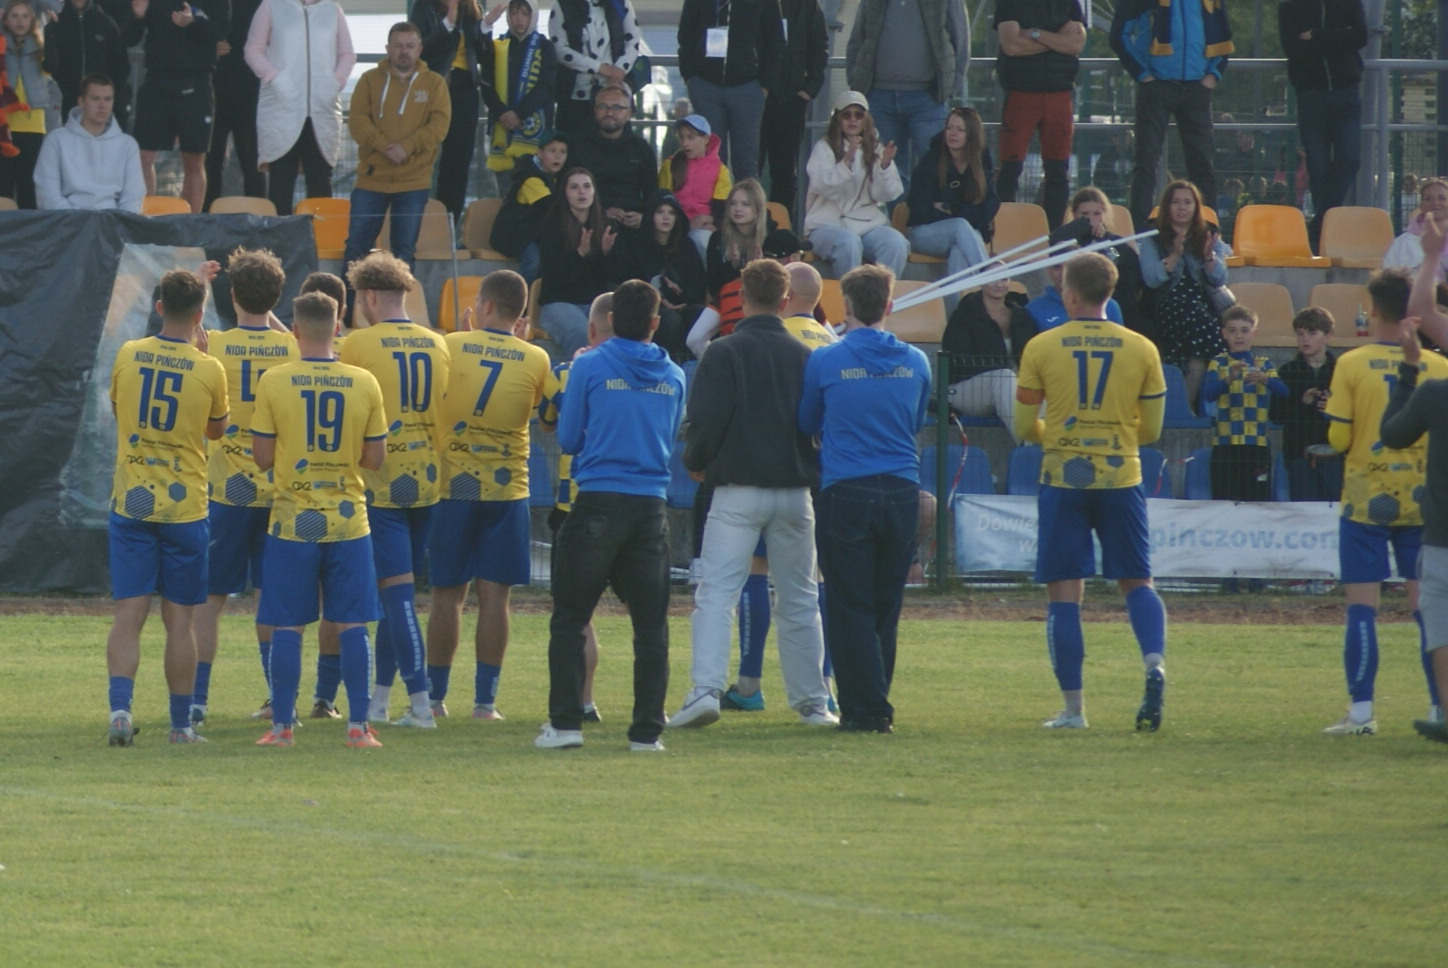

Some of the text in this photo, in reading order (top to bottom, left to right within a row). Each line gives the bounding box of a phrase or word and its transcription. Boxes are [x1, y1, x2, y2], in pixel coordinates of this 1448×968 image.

[133, 351, 195, 371] NIDA PIŃCZÓW
[225, 344, 289, 357] NIDA PIŃCZÓW
[381, 337, 401, 348] NIDA
[462, 343, 526, 362] NIDA PIŃCZÓW
[138, 366, 184, 432] 15
[291, 375, 354, 388] NIDA PIŃCZÓW
[392, 351, 433, 413] 10
[472, 359, 504, 417] 7
[1072, 350, 1114, 410] 17
[300, 389, 345, 452] 19
